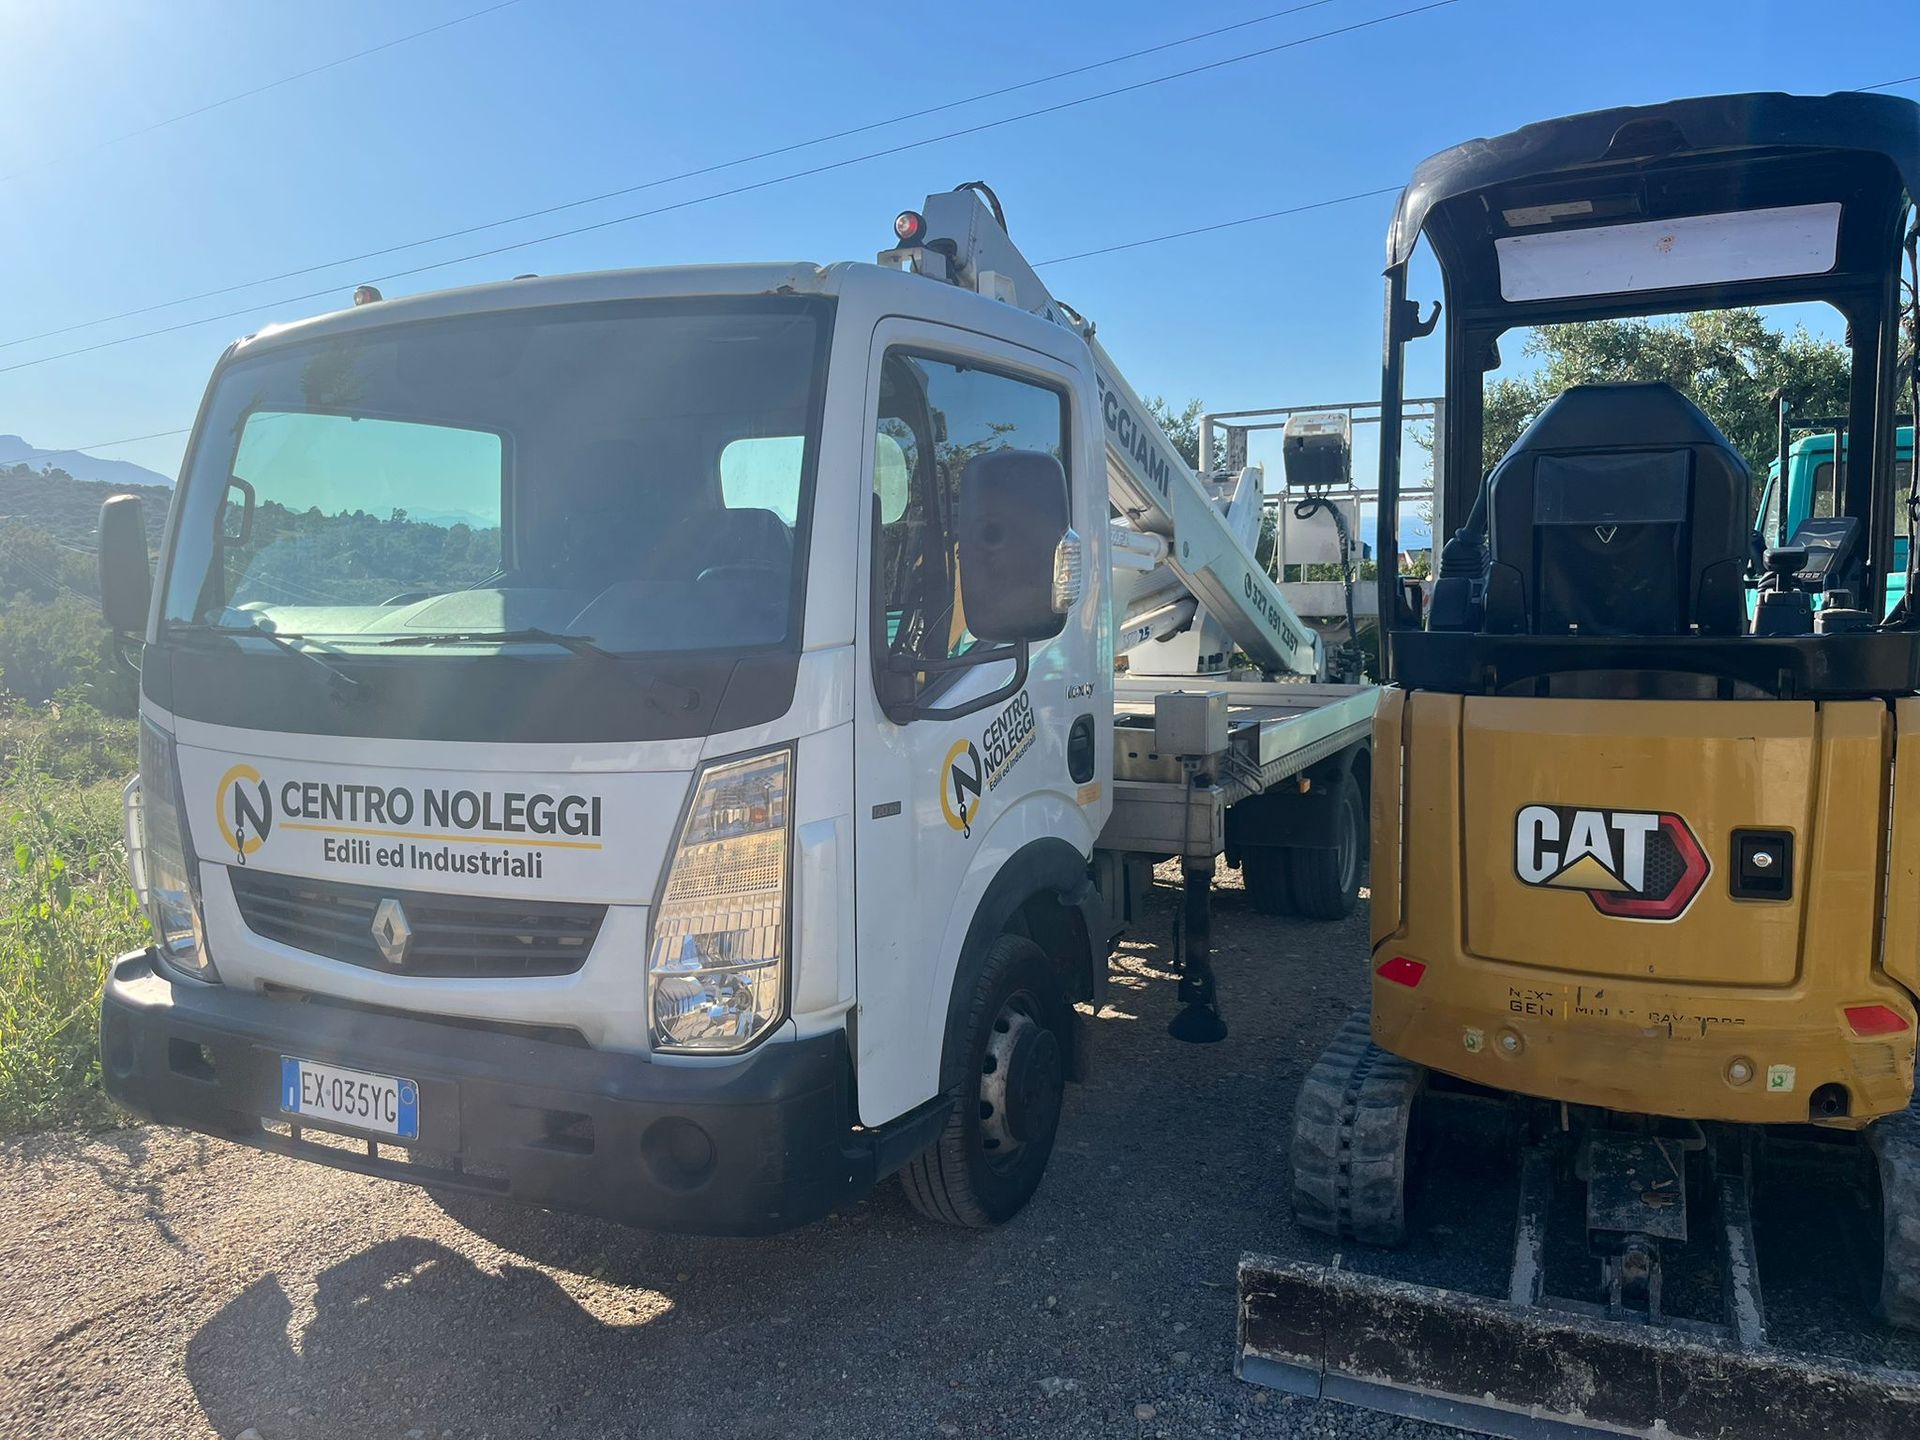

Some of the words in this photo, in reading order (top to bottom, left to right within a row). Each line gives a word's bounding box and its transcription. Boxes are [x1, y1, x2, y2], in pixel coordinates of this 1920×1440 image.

[1252, 583, 1267, 616] 327
[1268, 605, 1280, 635] 691
[982, 689, 1029, 752] CENTRO
[983, 707, 1035, 779] NOLEGGI
[280, 780, 414, 825] CENTRO
[423, 788, 602, 836] NOLEGGI
[323, 838, 371, 866] Edili
[376, 844, 405, 868] ed
[410, 845, 542, 878] Industriali
[1516, 806, 1659, 893] CAT
